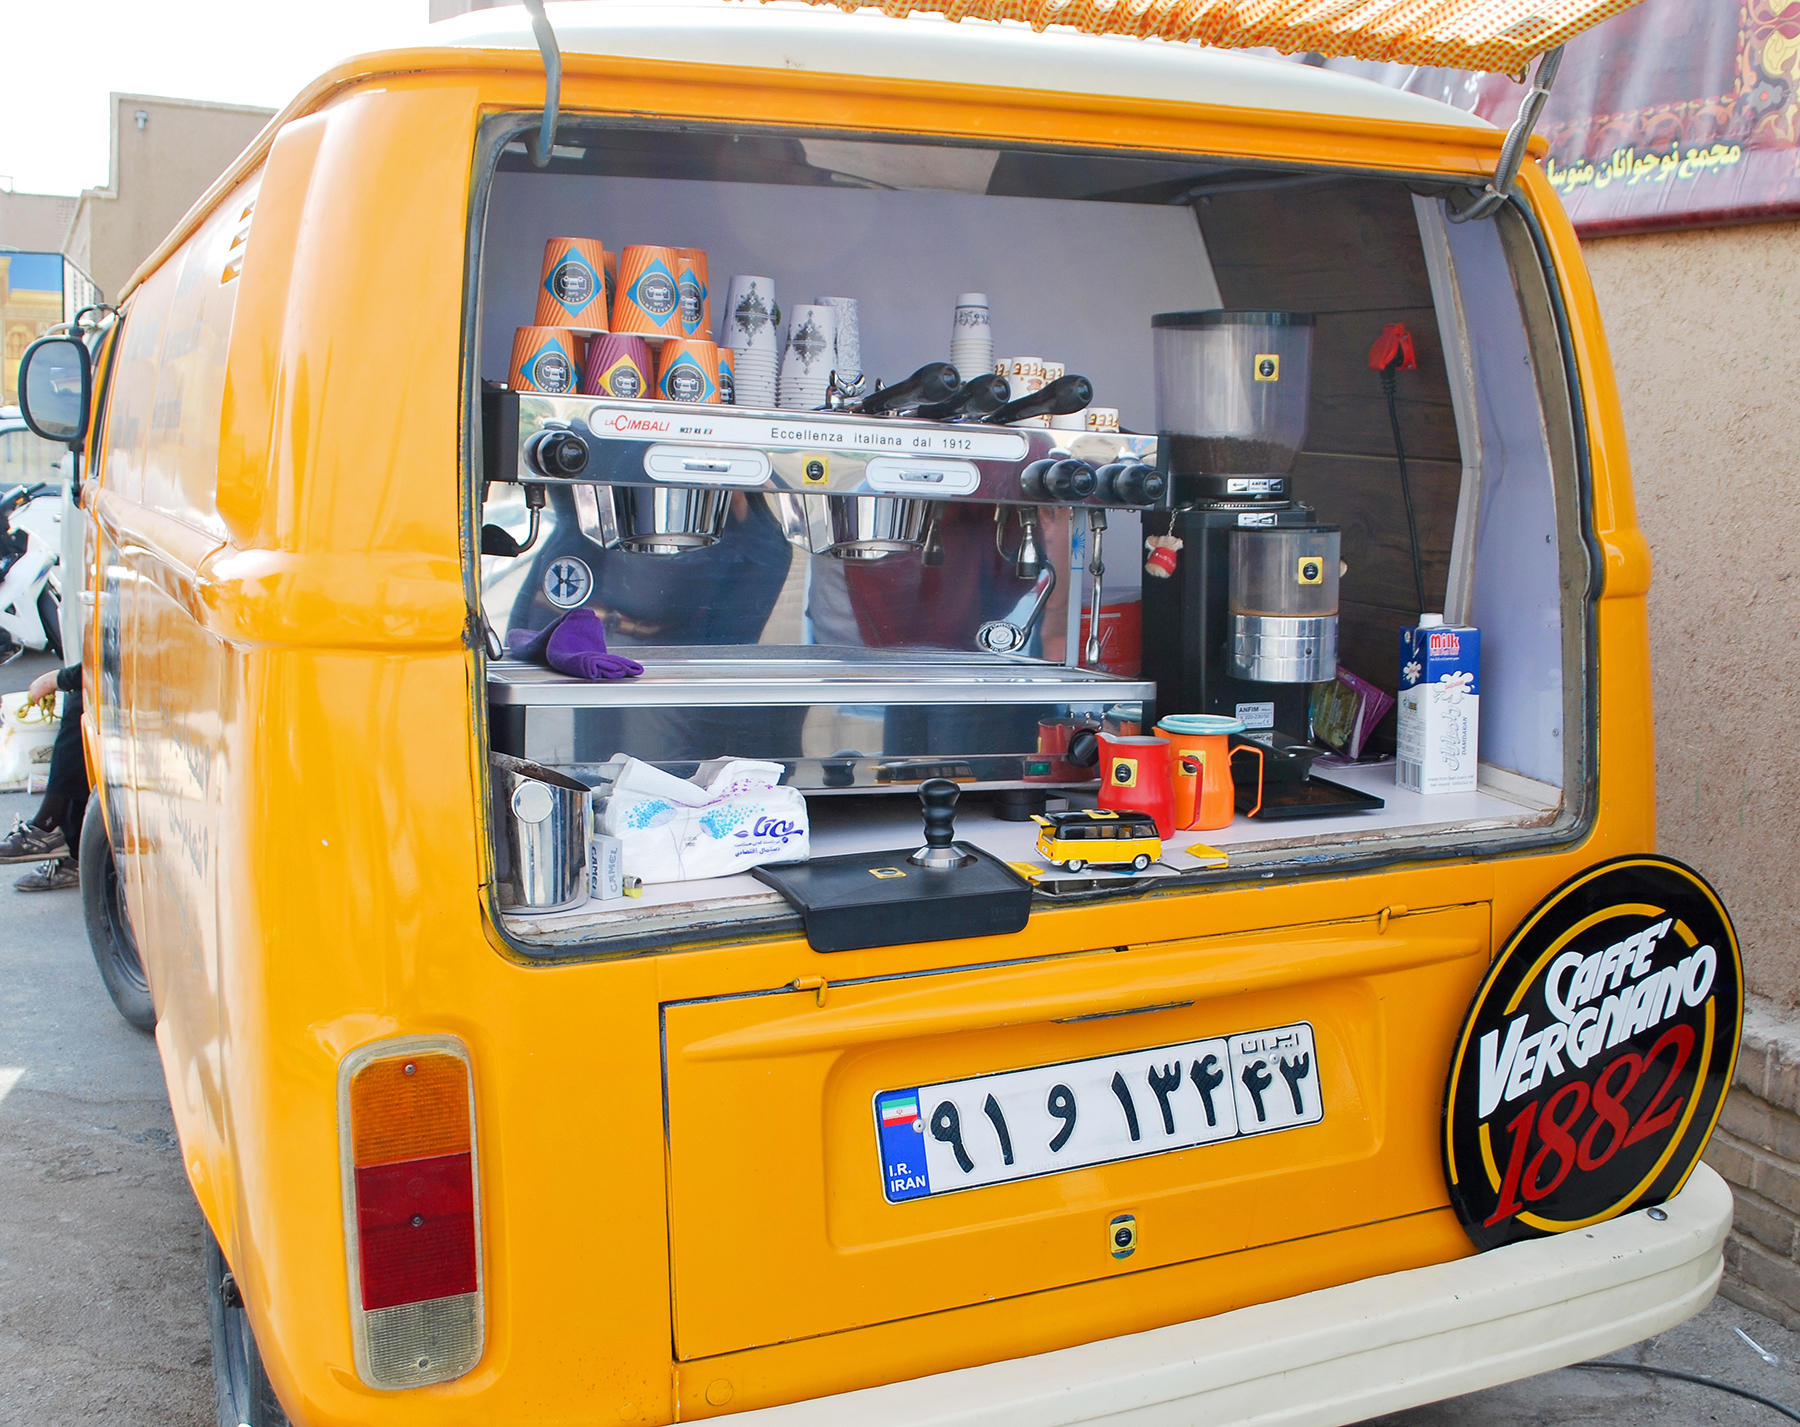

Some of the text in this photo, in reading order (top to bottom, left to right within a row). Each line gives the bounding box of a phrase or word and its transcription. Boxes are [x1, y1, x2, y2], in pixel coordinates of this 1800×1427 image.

[1594, 141, 1680, 189] نوجوانان
[1677, 143, 1741, 179] مجمع
[614, 414, 671, 432] CIMBALI
[771, 427, 972, 450] Eccellenza italiana dal 1912
[608, 847, 618, 893] CAMEL
[1483, 1023, 1696, 1228] 1882
[888, 1163, 913, 1177] I.R.
[890, 1173, 926, 1193] IRAN
